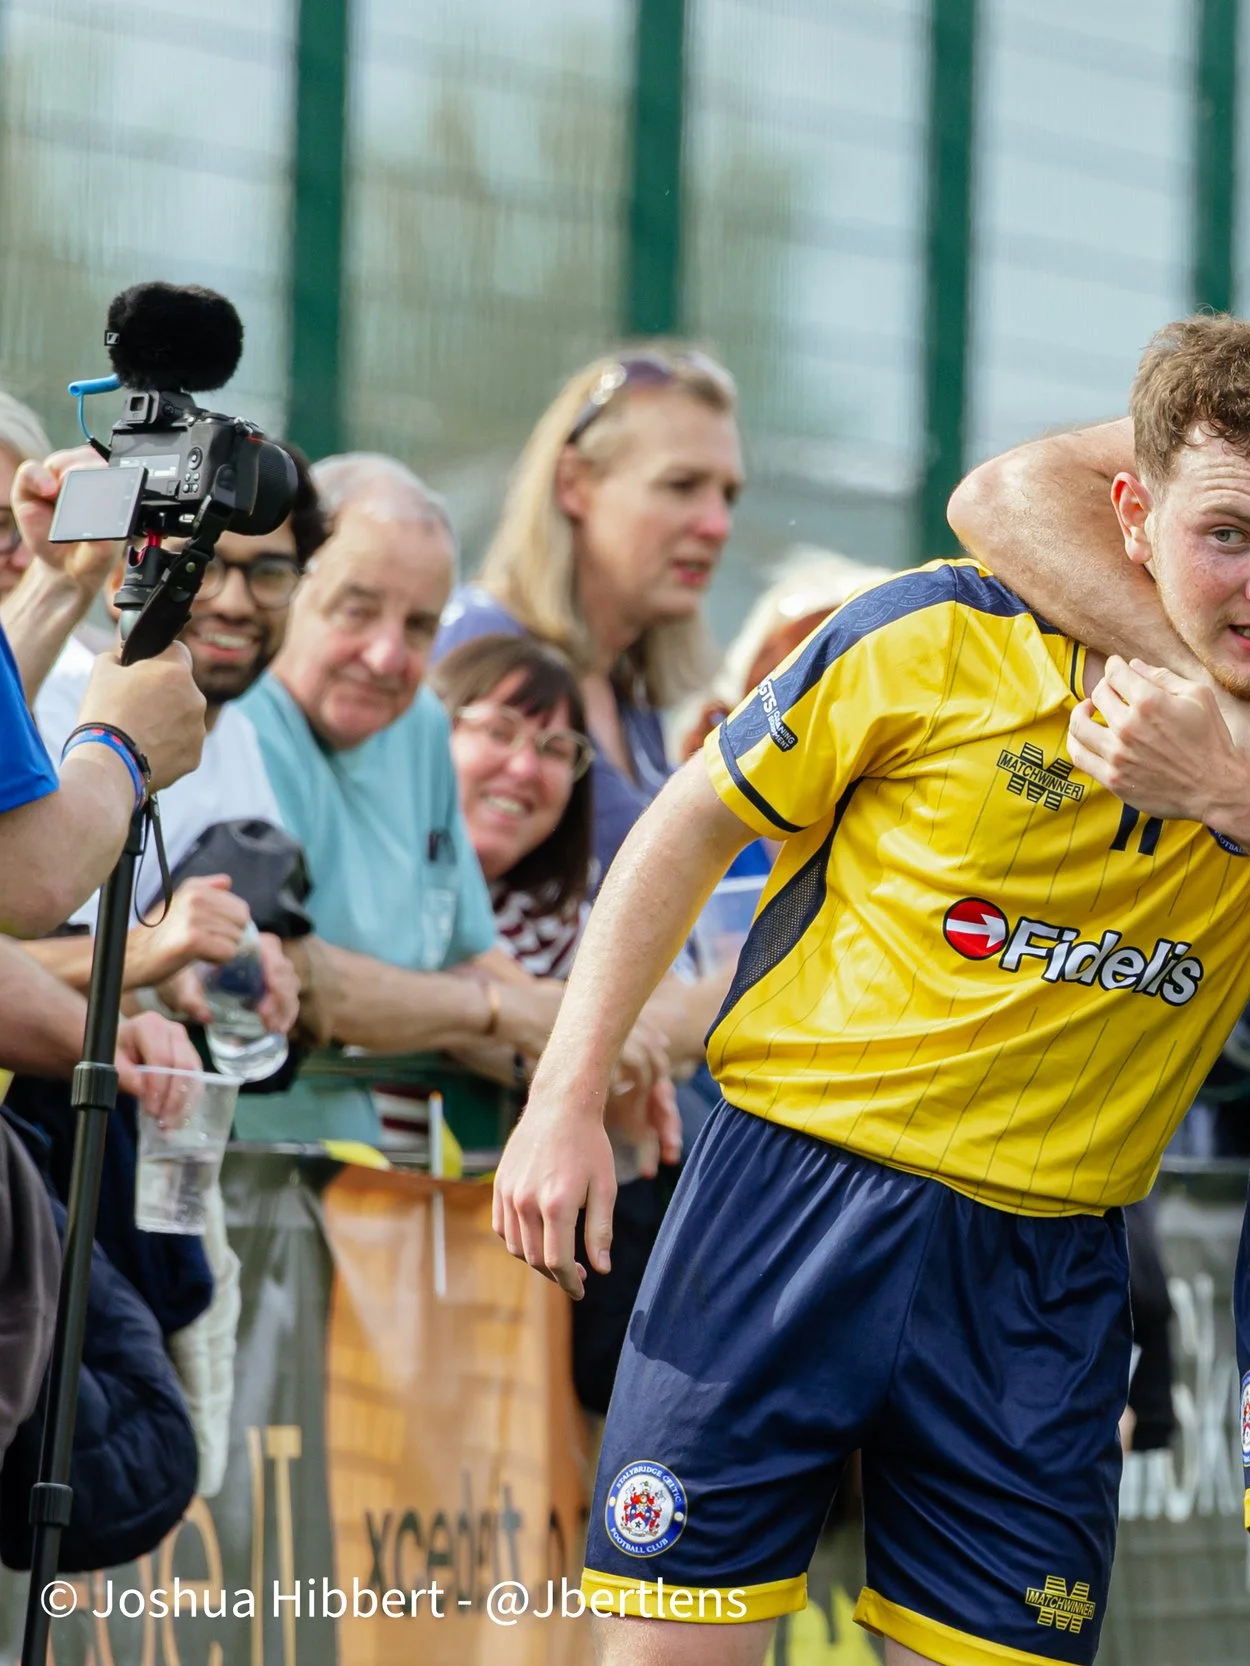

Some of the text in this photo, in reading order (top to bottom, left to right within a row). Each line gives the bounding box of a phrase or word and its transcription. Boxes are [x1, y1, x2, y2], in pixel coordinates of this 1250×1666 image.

[1000, 753, 1082, 801] MATCHWINNER
[999, 916, 1204, 1006] Fidelis
[615, 1465, 683, 1503] STALYBRIDGE CELTIC
[610, 1527, 669, 1554] FOOTBALL CLUB
[1027, 1590, 1095, 1617] MATCHWINNER
